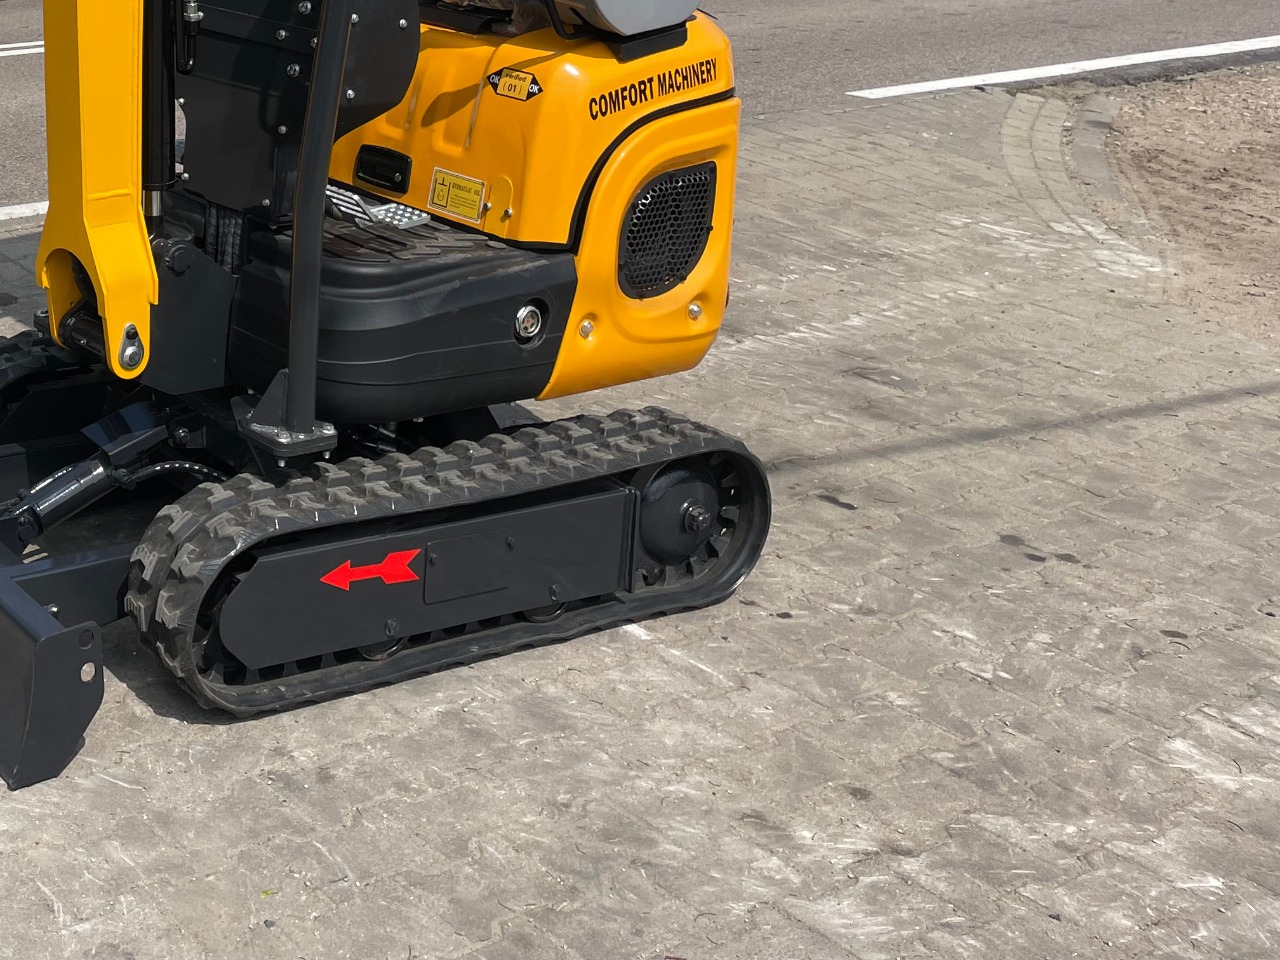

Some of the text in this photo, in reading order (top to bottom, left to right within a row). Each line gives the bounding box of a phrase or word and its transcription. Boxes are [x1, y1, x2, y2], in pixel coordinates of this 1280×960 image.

[489, 74, 501, 84] OK
[528, 83, 540, 94] OK
[588, 57, 717, 121] COMFORT MACHINERY
